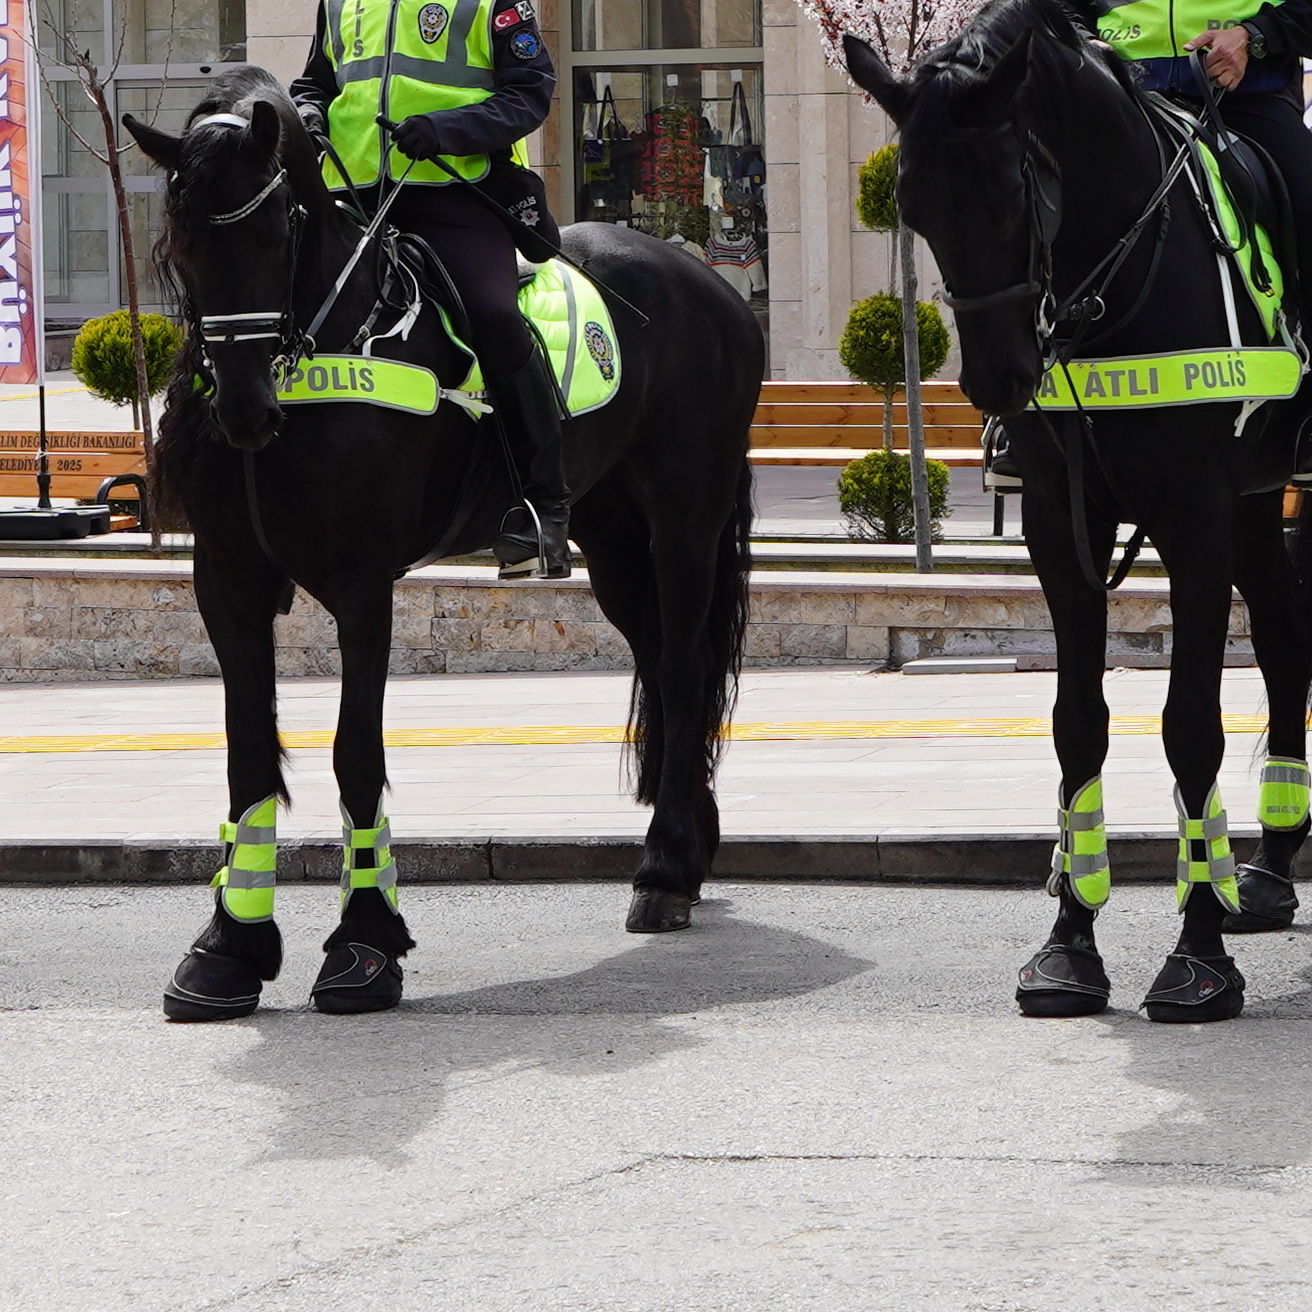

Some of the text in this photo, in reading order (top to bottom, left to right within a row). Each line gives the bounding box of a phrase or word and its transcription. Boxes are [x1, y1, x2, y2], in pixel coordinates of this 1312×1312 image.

[285, 361, 375, 393] POLİS
[1085, 367, 1159, 399] ATLI
[1184, 353, 1246, 390] POLİS
[57, 459, 82, 471] 2025
